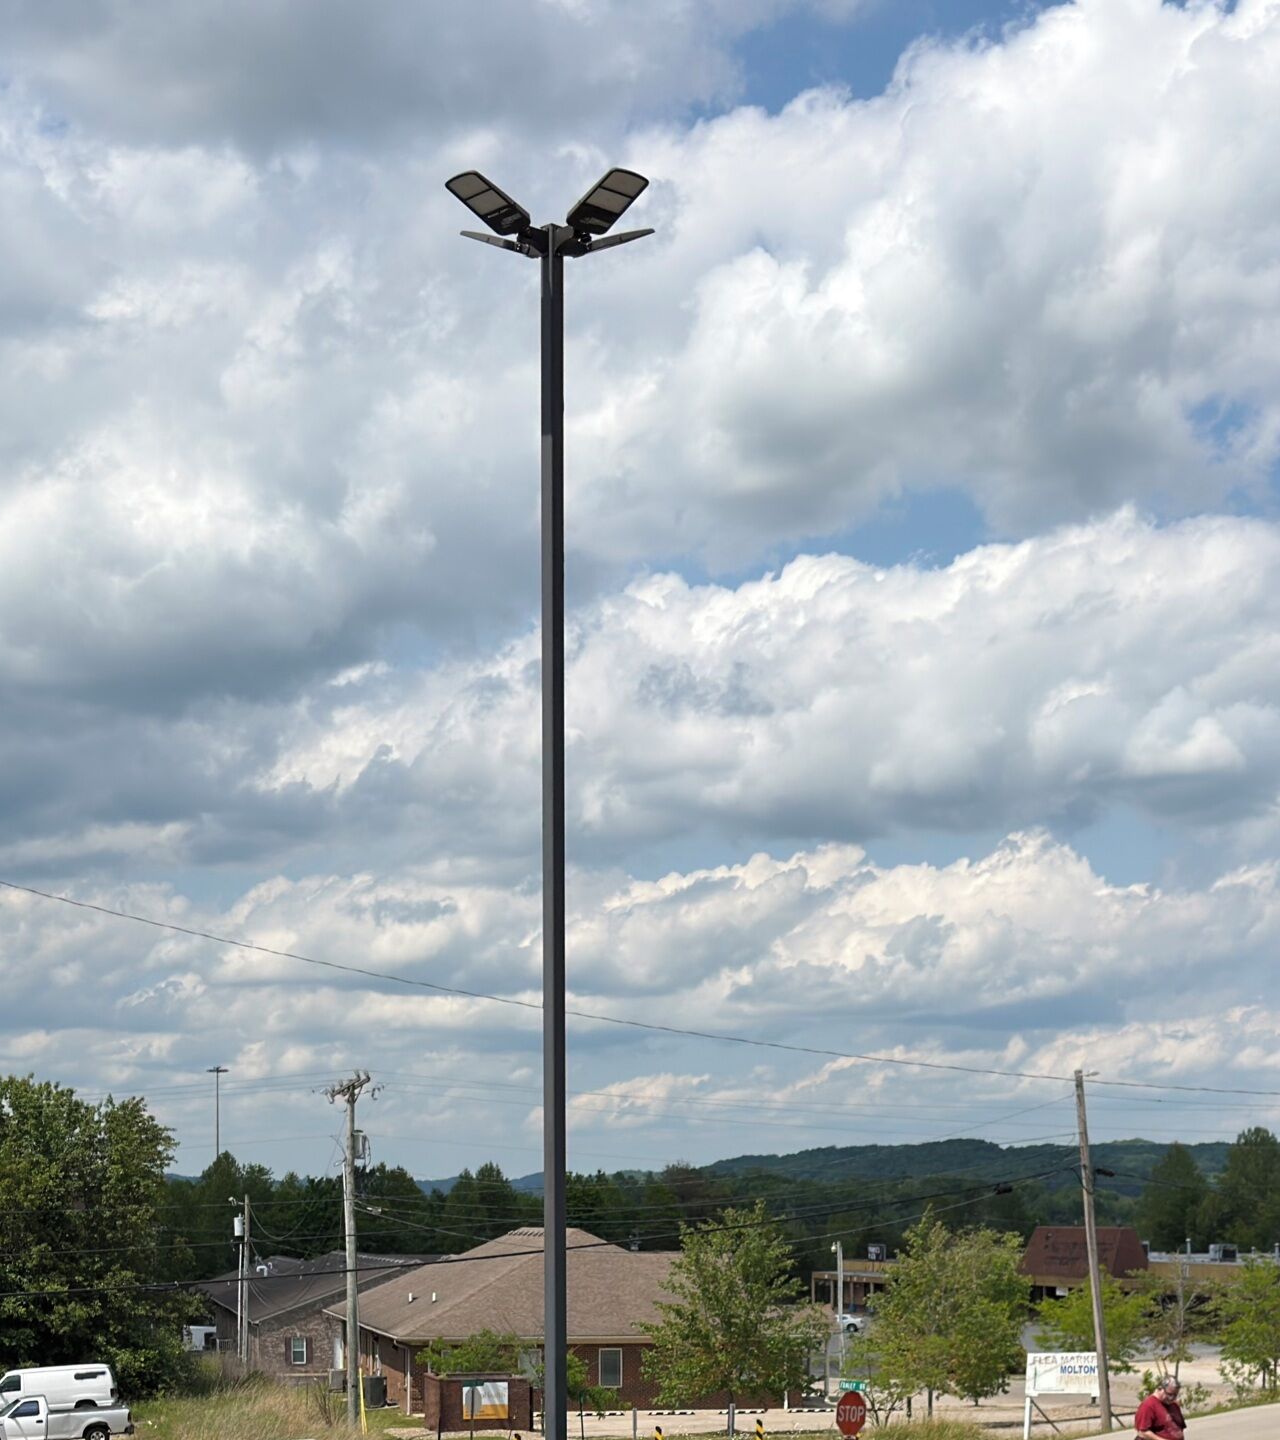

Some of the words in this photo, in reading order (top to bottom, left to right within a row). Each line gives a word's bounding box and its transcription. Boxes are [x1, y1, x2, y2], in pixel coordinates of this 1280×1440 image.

[1030, 1355, 1058, 1365] FLEA
[1061, 1355, 1097, 1364] MARKE
[1061, 1365, 1099, 1374] MOLTON'
[838, 1405, 865, 1422] STOP
